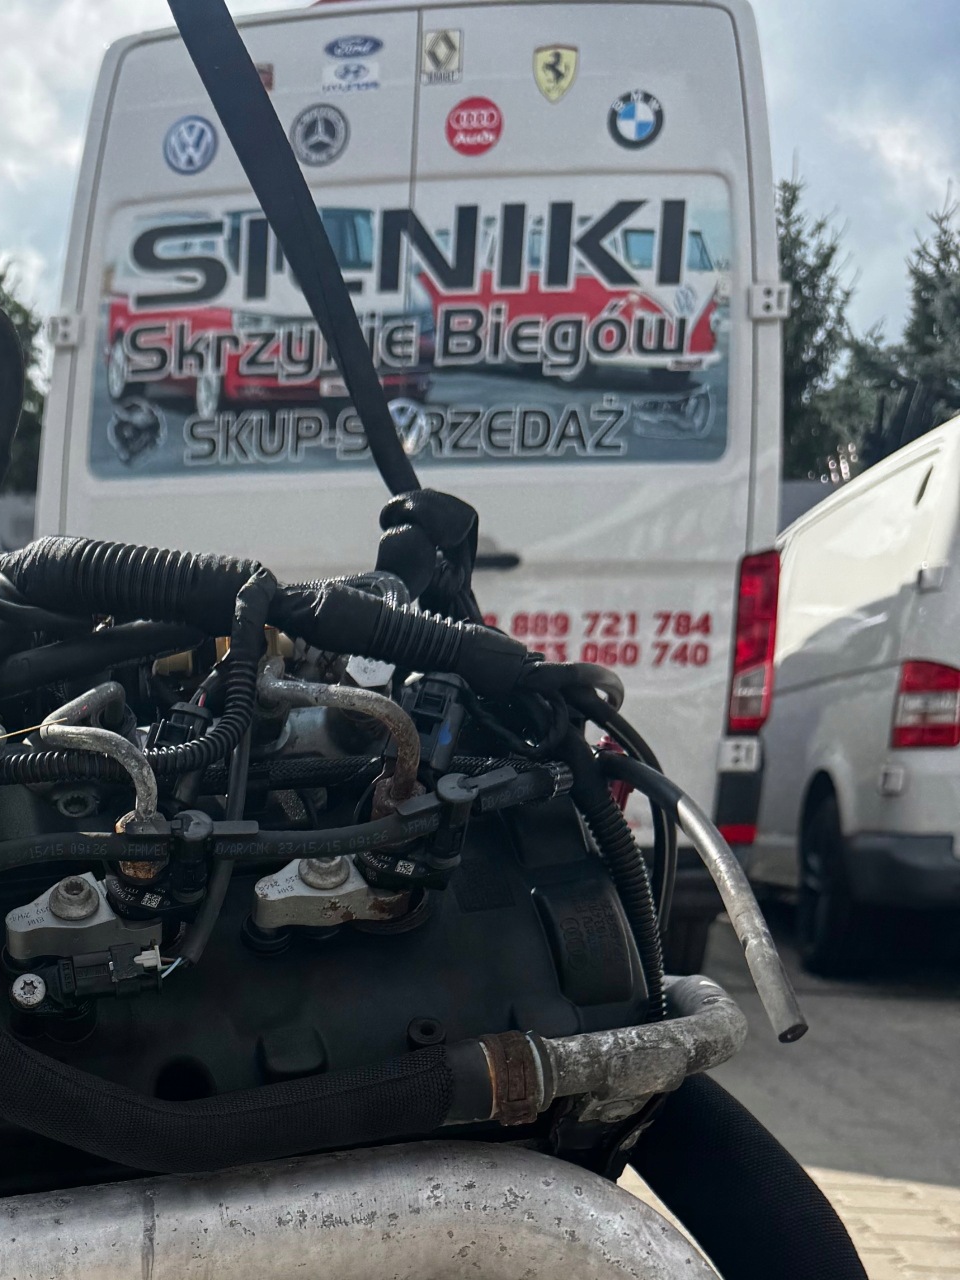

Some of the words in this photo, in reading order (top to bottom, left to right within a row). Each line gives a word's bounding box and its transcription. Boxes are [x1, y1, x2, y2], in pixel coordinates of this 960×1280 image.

[131, 199, 687, 306] SINIKI
[126, 311, 417, 381] Skrzyie
[441, 300, 690, 372] Biegów
[187, 395, 625, 462] SKUP-SRZEDAŻ
[581, 643, 639, 666] 060
[652, 642, 709, 667] 740
[583, 611, 638, 637] 721
[654, 611, 712, 637] 784
